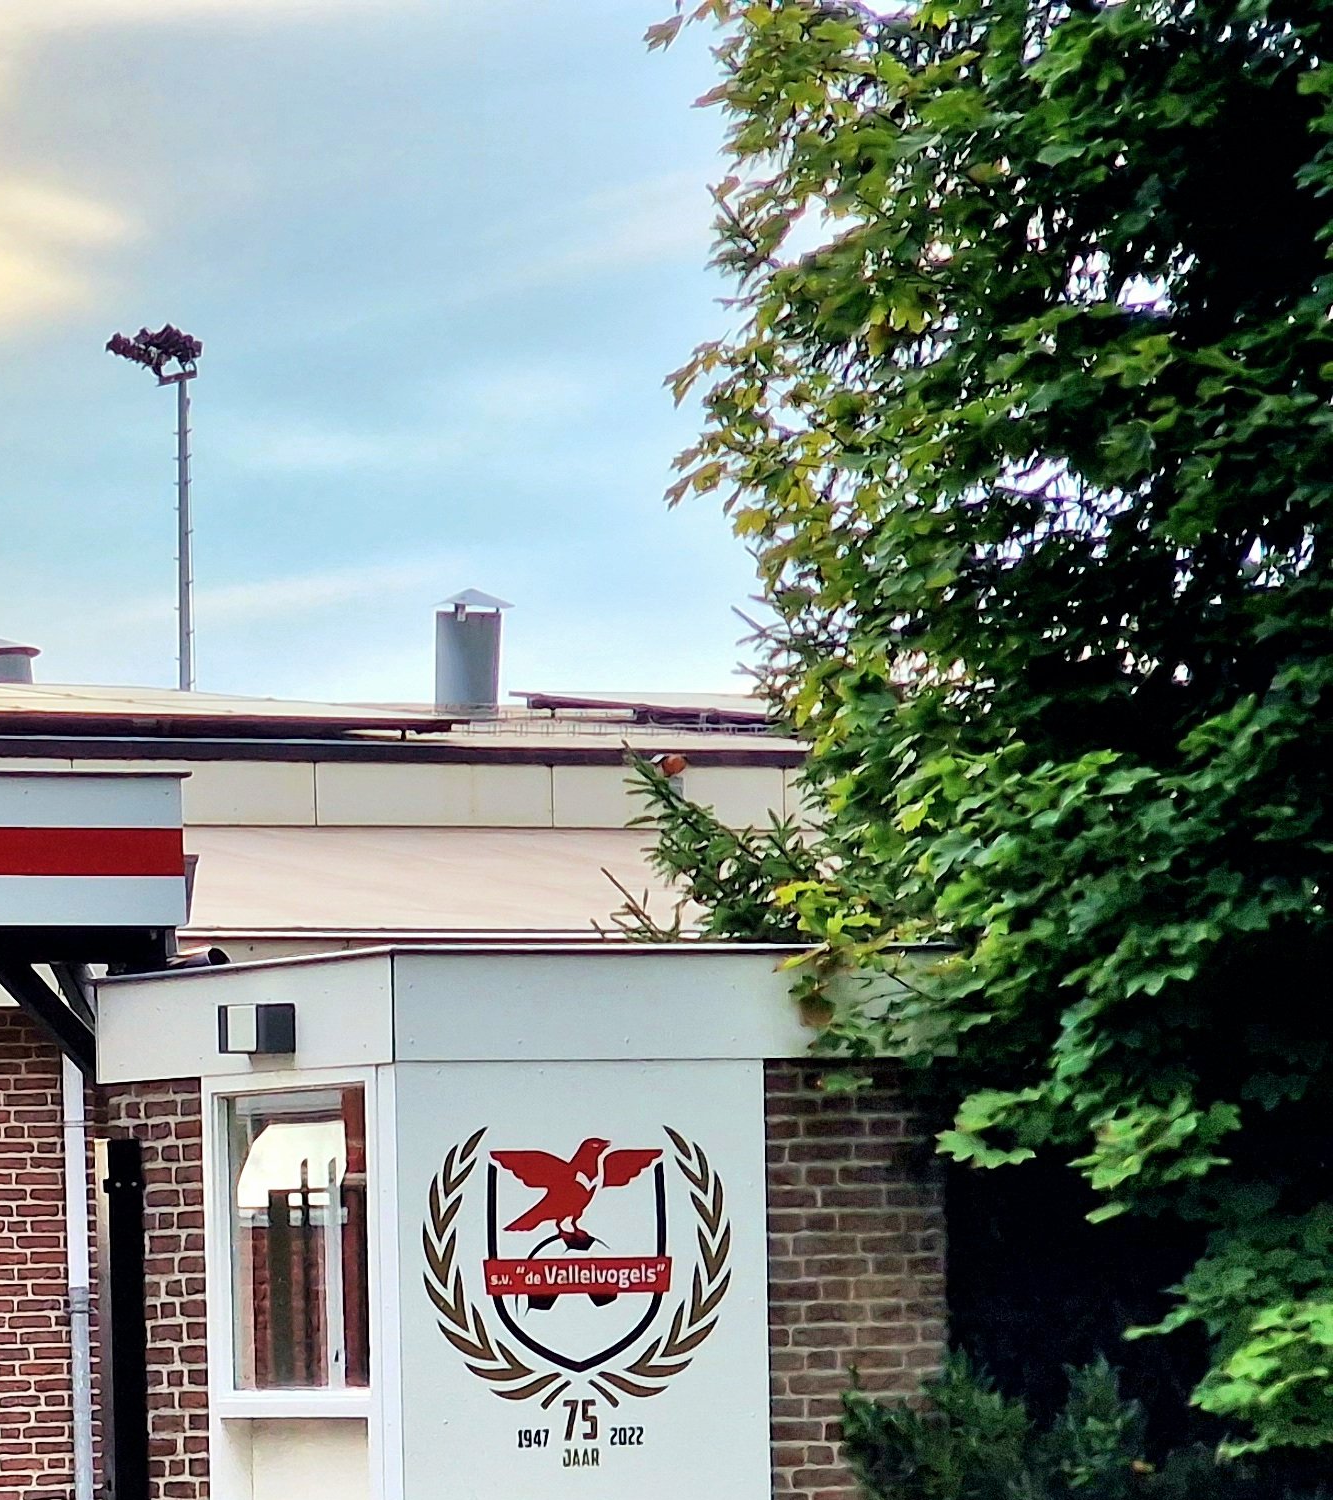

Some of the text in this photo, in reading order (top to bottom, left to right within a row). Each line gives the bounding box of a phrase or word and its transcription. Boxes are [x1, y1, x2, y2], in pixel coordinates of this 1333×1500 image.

[490, 1274, 513, 1286] s.v.
[562, 1399, 598, 1441] 75
[517, 1426, 644, 1448] 1947 2022
[562, 1447, 600, 1467] JAAR
